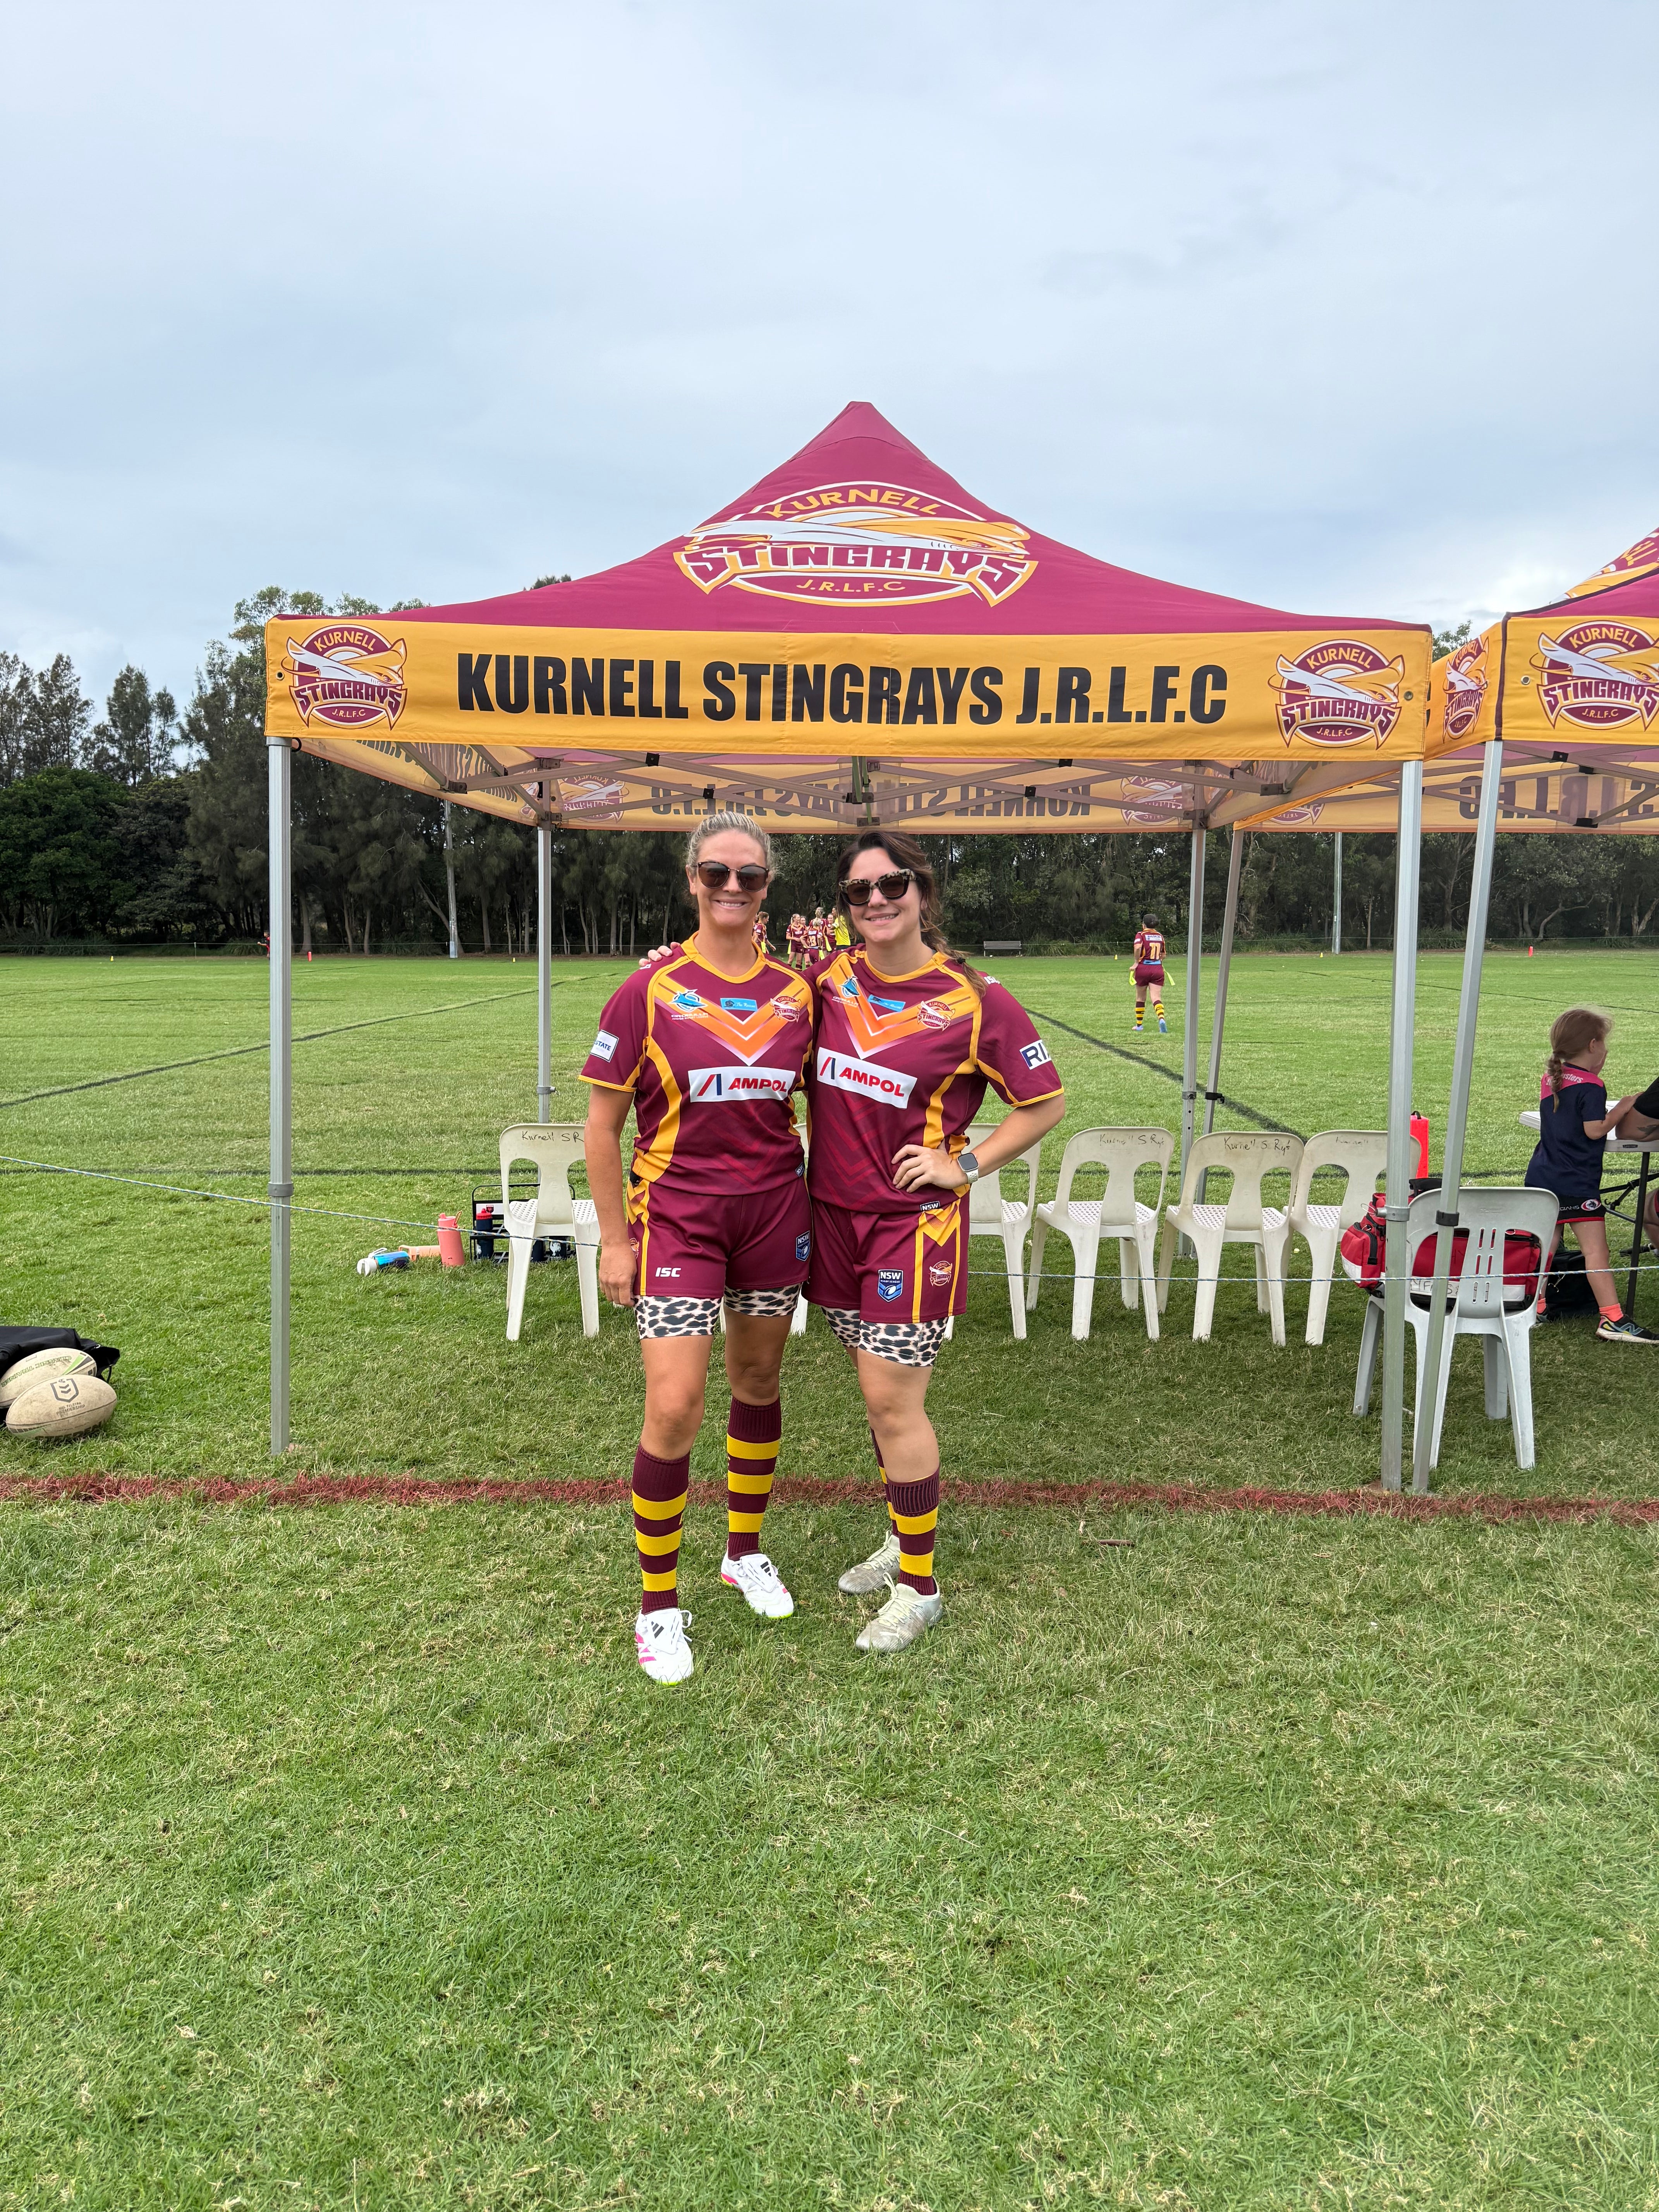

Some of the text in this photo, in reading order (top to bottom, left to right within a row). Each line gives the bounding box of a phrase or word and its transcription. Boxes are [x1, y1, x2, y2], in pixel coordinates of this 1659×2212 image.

[768, 489, 941, 518] KURNELL
[684, 546, 1027, 599] STINGRAYS
[796, 579, 906, 593] J.R.L.F.C
[314, 631, 377, 652] KURNELL
[1569, 627, 1638, 648] KURNELL
[1307, 647, 1374, 669] KURNELL
[458, 653, 1228, 725] KURNELL STINGRAYS J.R.L.F.C
[1543, 681, 1659, 718] STINGRAYS
[295, 682, 402, 721] STINGRAYS
[332, 708, 366, 718] J.R.L.F.C
[1281, 699, 1395, 739] STINGRAYS
[1582, 709, 1619, 718] J.R.L.F.C
[1317, 728, 1353, 737] J.R.L.F.C
[1149, 943, 1161, 960] 11
[728, 1077, 787, 1092] AMPOL
[839, 1067, 905, 1097] AMPOL
[922, 1202, 939, 1211] NSW
[798, 1233, 809, 1244] NSW
[655, 1267, 682, 1277] ISC
[880, 1271, 901, 1279] NSW
[1, 1366, 34, 1388] TRAINER
